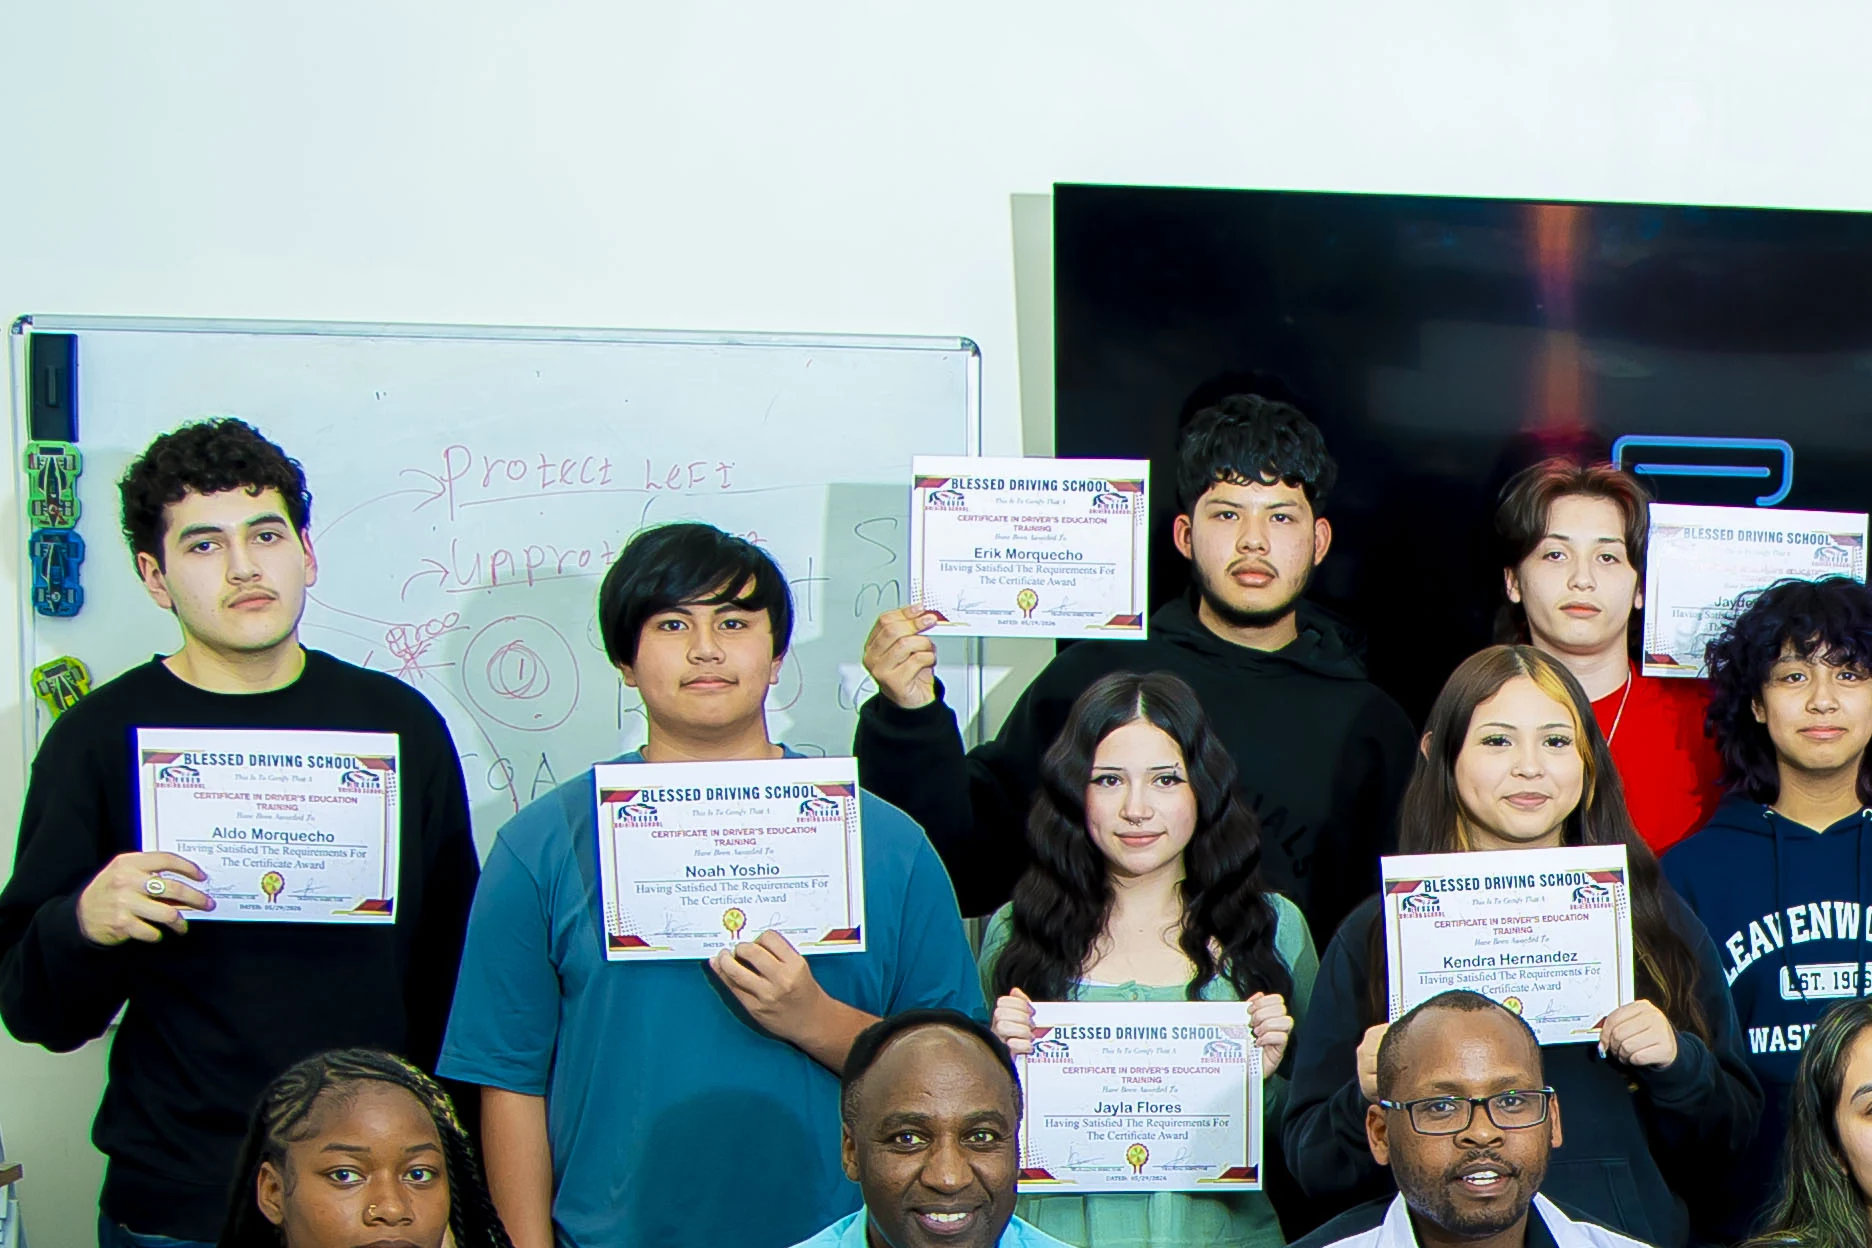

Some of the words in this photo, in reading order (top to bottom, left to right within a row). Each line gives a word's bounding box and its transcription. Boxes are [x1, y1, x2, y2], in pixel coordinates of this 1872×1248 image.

[951, 478, 1005, 490] BLESSED
[1010, 479, 1058, 491] DRIVING
[1063, 480, 1110, 493] SCHOOL
[1683, 527, 1734, 541] BLESSED
[1737, 529, 1783, 543] DRIVING
[1787, 532, 1832, 546] SCHOOL
[974, 548, 1001, 559] Erik
[1006, 549, 1083, 563] Morquecho
[184, 753, 244, 767] BLESSED
[249, 754, 303, 768] DRIVING
[308, 756, 359, 769] SCHOOL
[641, 789, 701, 803] BLESSED
[706, 787, 760, 801] DRIVING
[765, 785, 818, 799] SCHOOL
[212, 827, 247, 839] Aldo
[251, 829, 335, 843] Morquecho
[651, 829, 708, 839] CERTIFICATE
[711, 829, 720, 837] IN
[767, 826, 817, 835] EDUCATION
[714, 838, 757, 846] TRAINING
[685, 865, 725, 878] Noah
[729, 864, 780, 876] Yoshio
[1424, 877, 1480, 893] BLESSED
[1484, 874, 1535, 890] DRIVING
[1540, 872, 1589, 888] SCHOOL
[1443, 954, 1496, 969] Kendra
[1500, 951, 1578, 966] Hernandez
[1054, 1026, 1111, 1039] BLESSED
[1116, 1027, 1167, 1039] DRIVING
[1172, 1027, 1222, 1039] SCHOOL
[1094, 1101, 1132, 1116] Jayla
[1137, 1101, 1182, 1113] Flores
